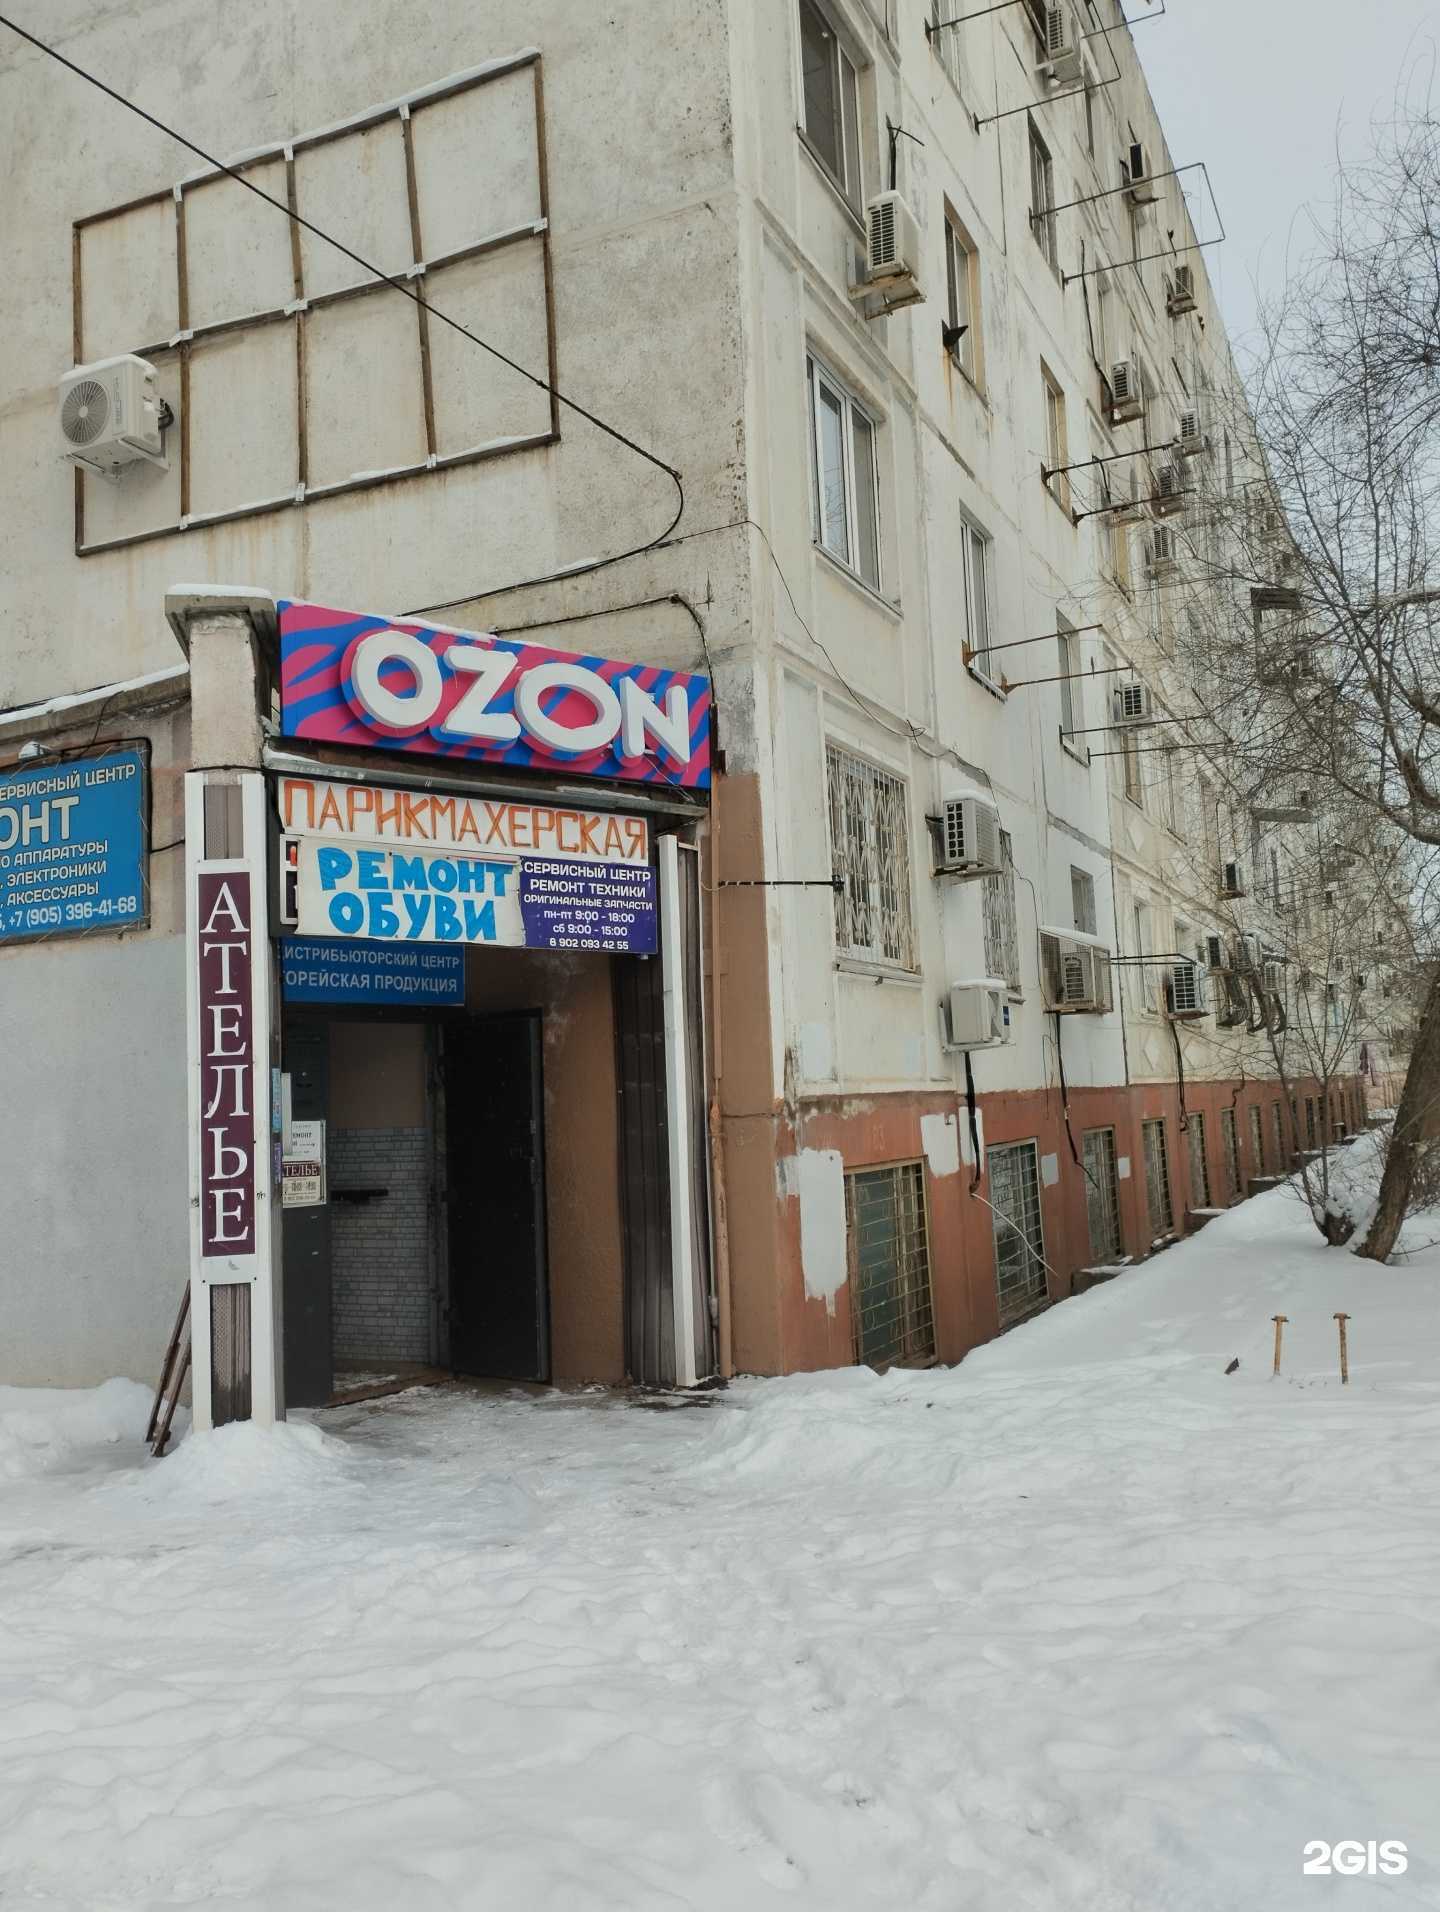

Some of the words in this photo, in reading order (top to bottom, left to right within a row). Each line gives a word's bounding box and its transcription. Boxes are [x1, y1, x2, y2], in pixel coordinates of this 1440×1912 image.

[351, 630, 690, 764] OZON
[85, 764, 136, 787] ЦЕНТР
[283, 779, 647, 860] ПАРИКМАХЕРСКАЯ
[14, 840, 108, 867] АППАРАТУРЫ
[7, 860, 107, 887] ЭЛЕКТРОНИКИ
[317, 847, 518, 897] РЕМОНТ
[524, 861, 607, 879] СЕРВИСНЫЙ
[610, 869, 651, 882] ЦЕНТР
[7, 881, 99, 906] АКСЕССУАРЫ
[530, 879, 585, 894] РЕМОНТ
[588, 883, 646, 898] ТЕХНИКИ
[9, 910, 23, 928] +7
[27, 905, 62, 928] (905)
[65, 895, 137, 921] 396-41-68
[524, 894, 602, 907] ОРИГИНАЛЬНЫЕ
[604, 900, 653, 911] ЗАПЧАСТИ
[329, 892, 496, 941] ОБУВИ
[543, 910, 572, 920] пн-пт
[575, 910, 599, 921] 9:00
[608, 912, 635, 923] 18:00
[553, 923, 565, 933] сб
[568, 924, 592, 935] 9:00
[601, 926, 628, 936] 15:00
[558, 938, 578, 948] 902
[581, 939, 600, 949] 093
[602, 940, 616, 950] 42
[617, 940, 629, 950] 55
[283, 945, 417, 967] ИСТРИБЬЮТОРСКИЙ
[421, 954, 460, 970] ЦЕНТР
[283, 969, 370, 989] ОРЕЙСКАЯ
[374, 974, 457, 994] ПРОДУКЦИЯ
[200, 881, 250, 1243] АТЕЛЬЕ
[283, 1165, 318, 1177] ТЕЛЬЕ
